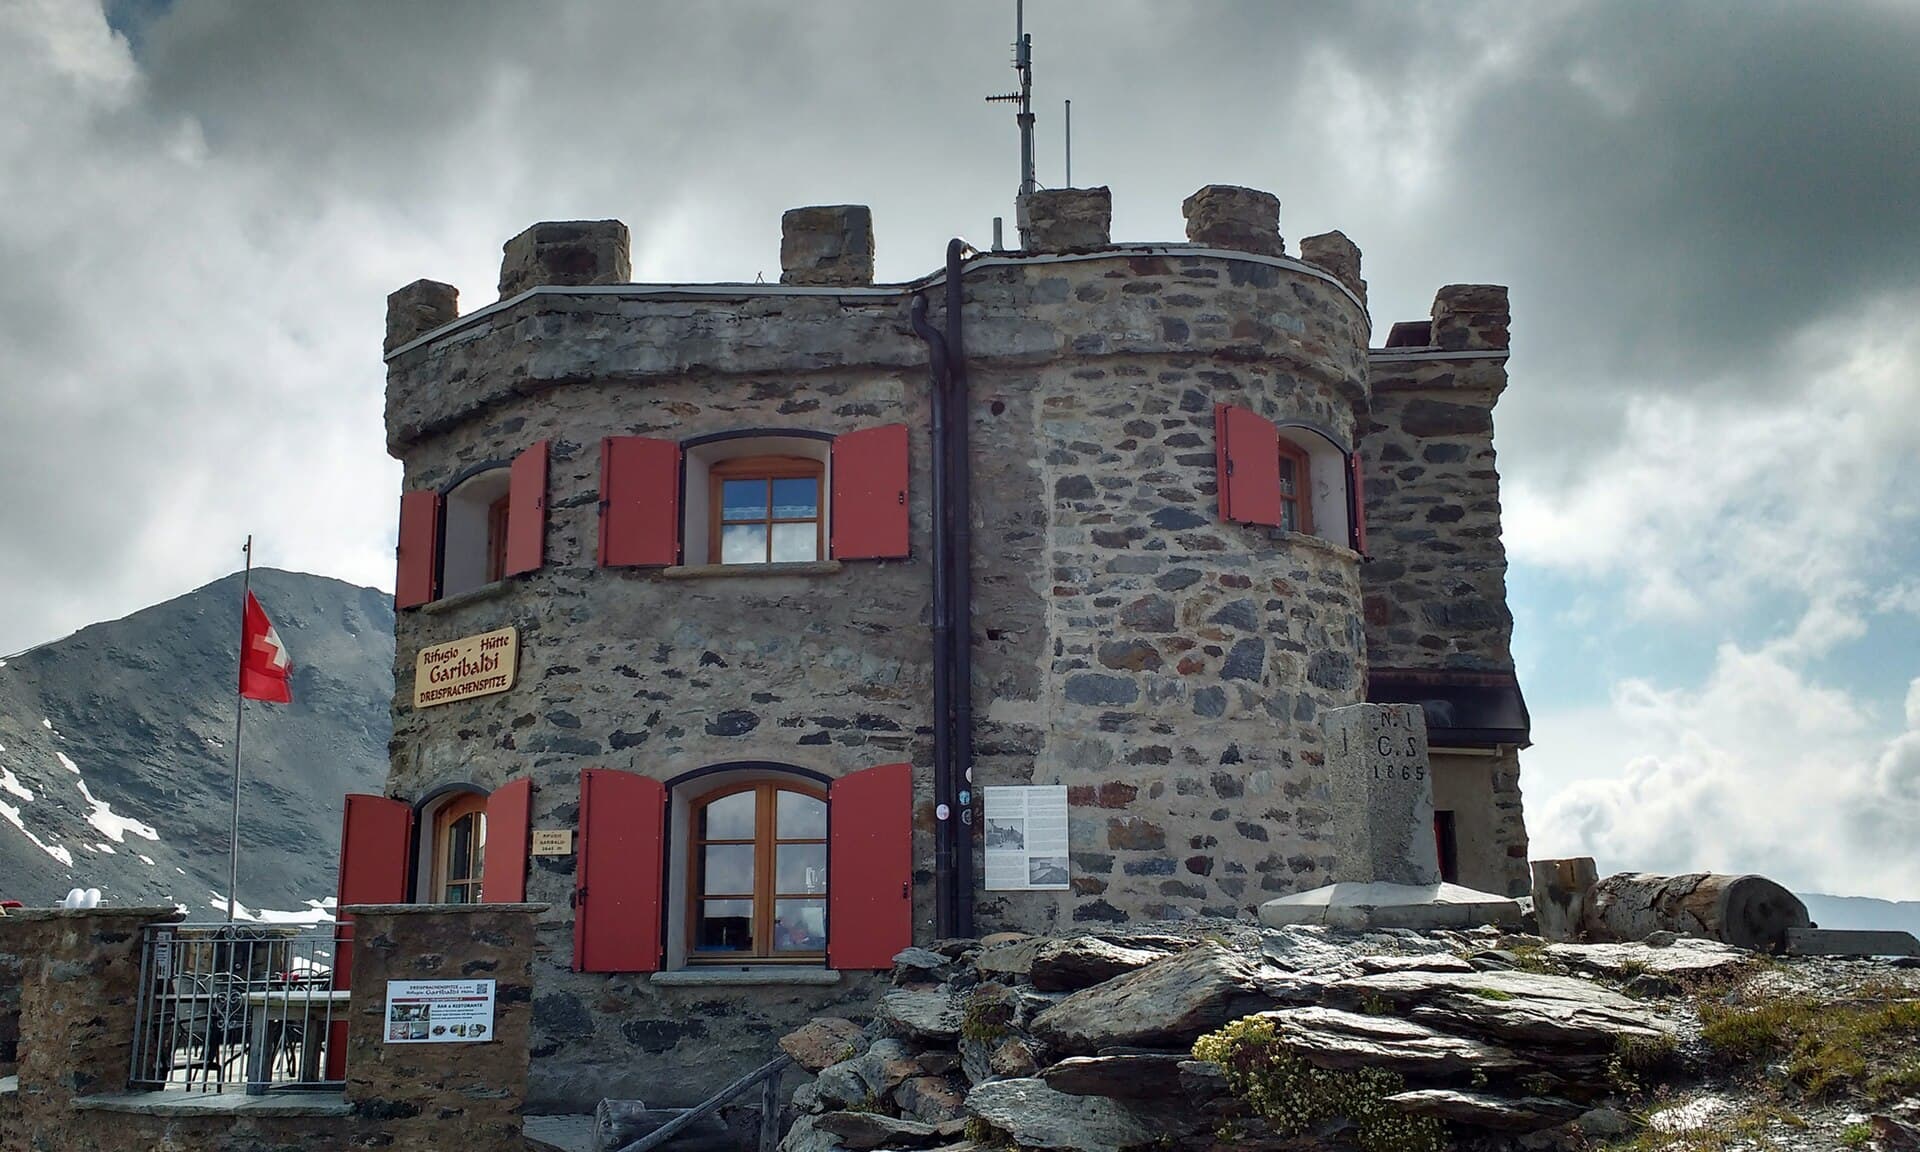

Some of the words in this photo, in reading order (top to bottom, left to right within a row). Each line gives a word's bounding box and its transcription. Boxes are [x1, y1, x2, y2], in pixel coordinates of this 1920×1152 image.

[424, 647, 458, 665] Rifugio
[481, 636, 509, 651] Hütte
[430, 653, 499, 684] Garibaldi
[420, 675, 507, 703] DREISPRACHENSPITZE
[1374, 765, 1424, 780] 1865
